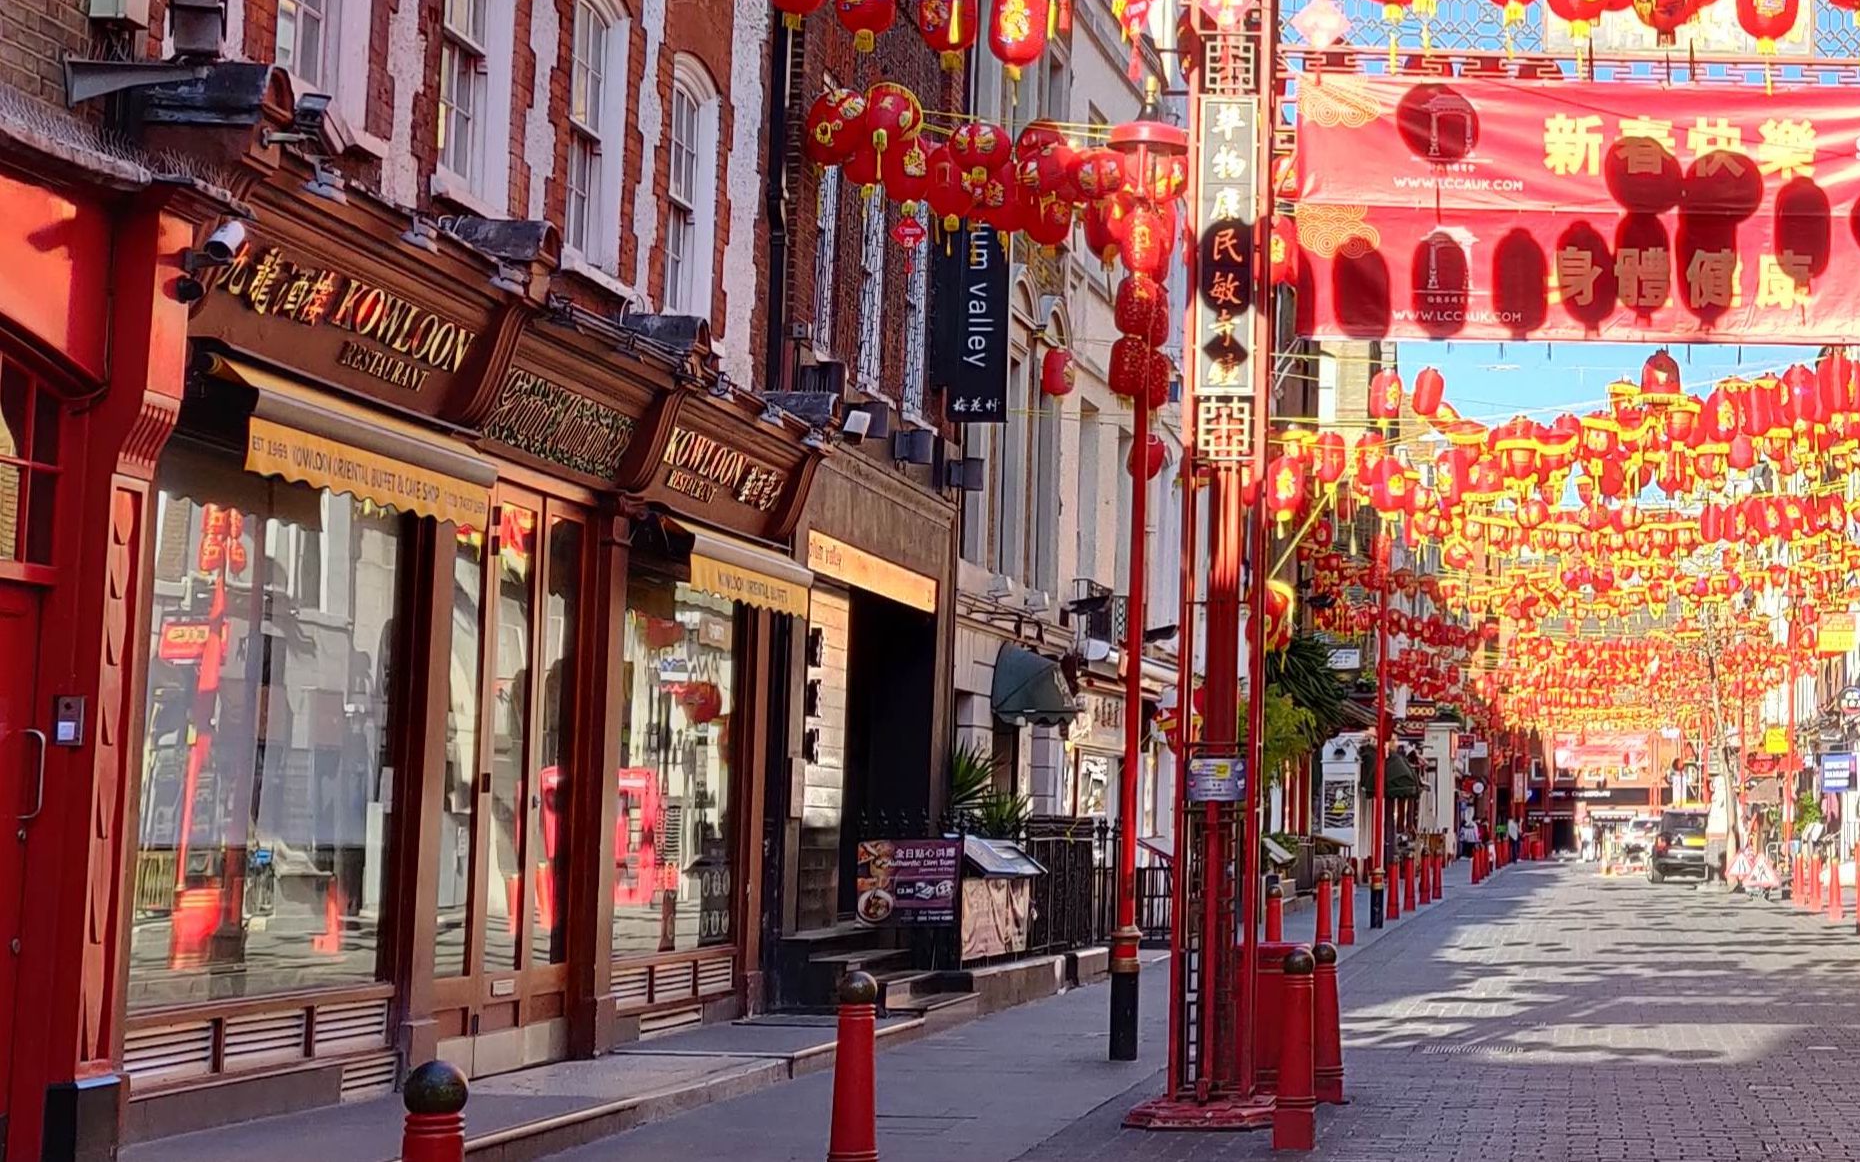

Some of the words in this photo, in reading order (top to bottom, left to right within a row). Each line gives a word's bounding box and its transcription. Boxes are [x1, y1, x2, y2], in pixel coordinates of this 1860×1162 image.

[1544, 112, 1817, 180] 新春快樂
[1392, 176, 1524, 191] WWW.LCCAUK.COM
[970, 222, 991, 270] lum
[1547, 245, 1814, 310] 身體健康
[330, 278, 477, 374] KOWLOON
[963, 282, 994, 368] valley
[341, 341, 432, 393] RESTAURANT
[662, 426, 751, 490] KOWLOON
